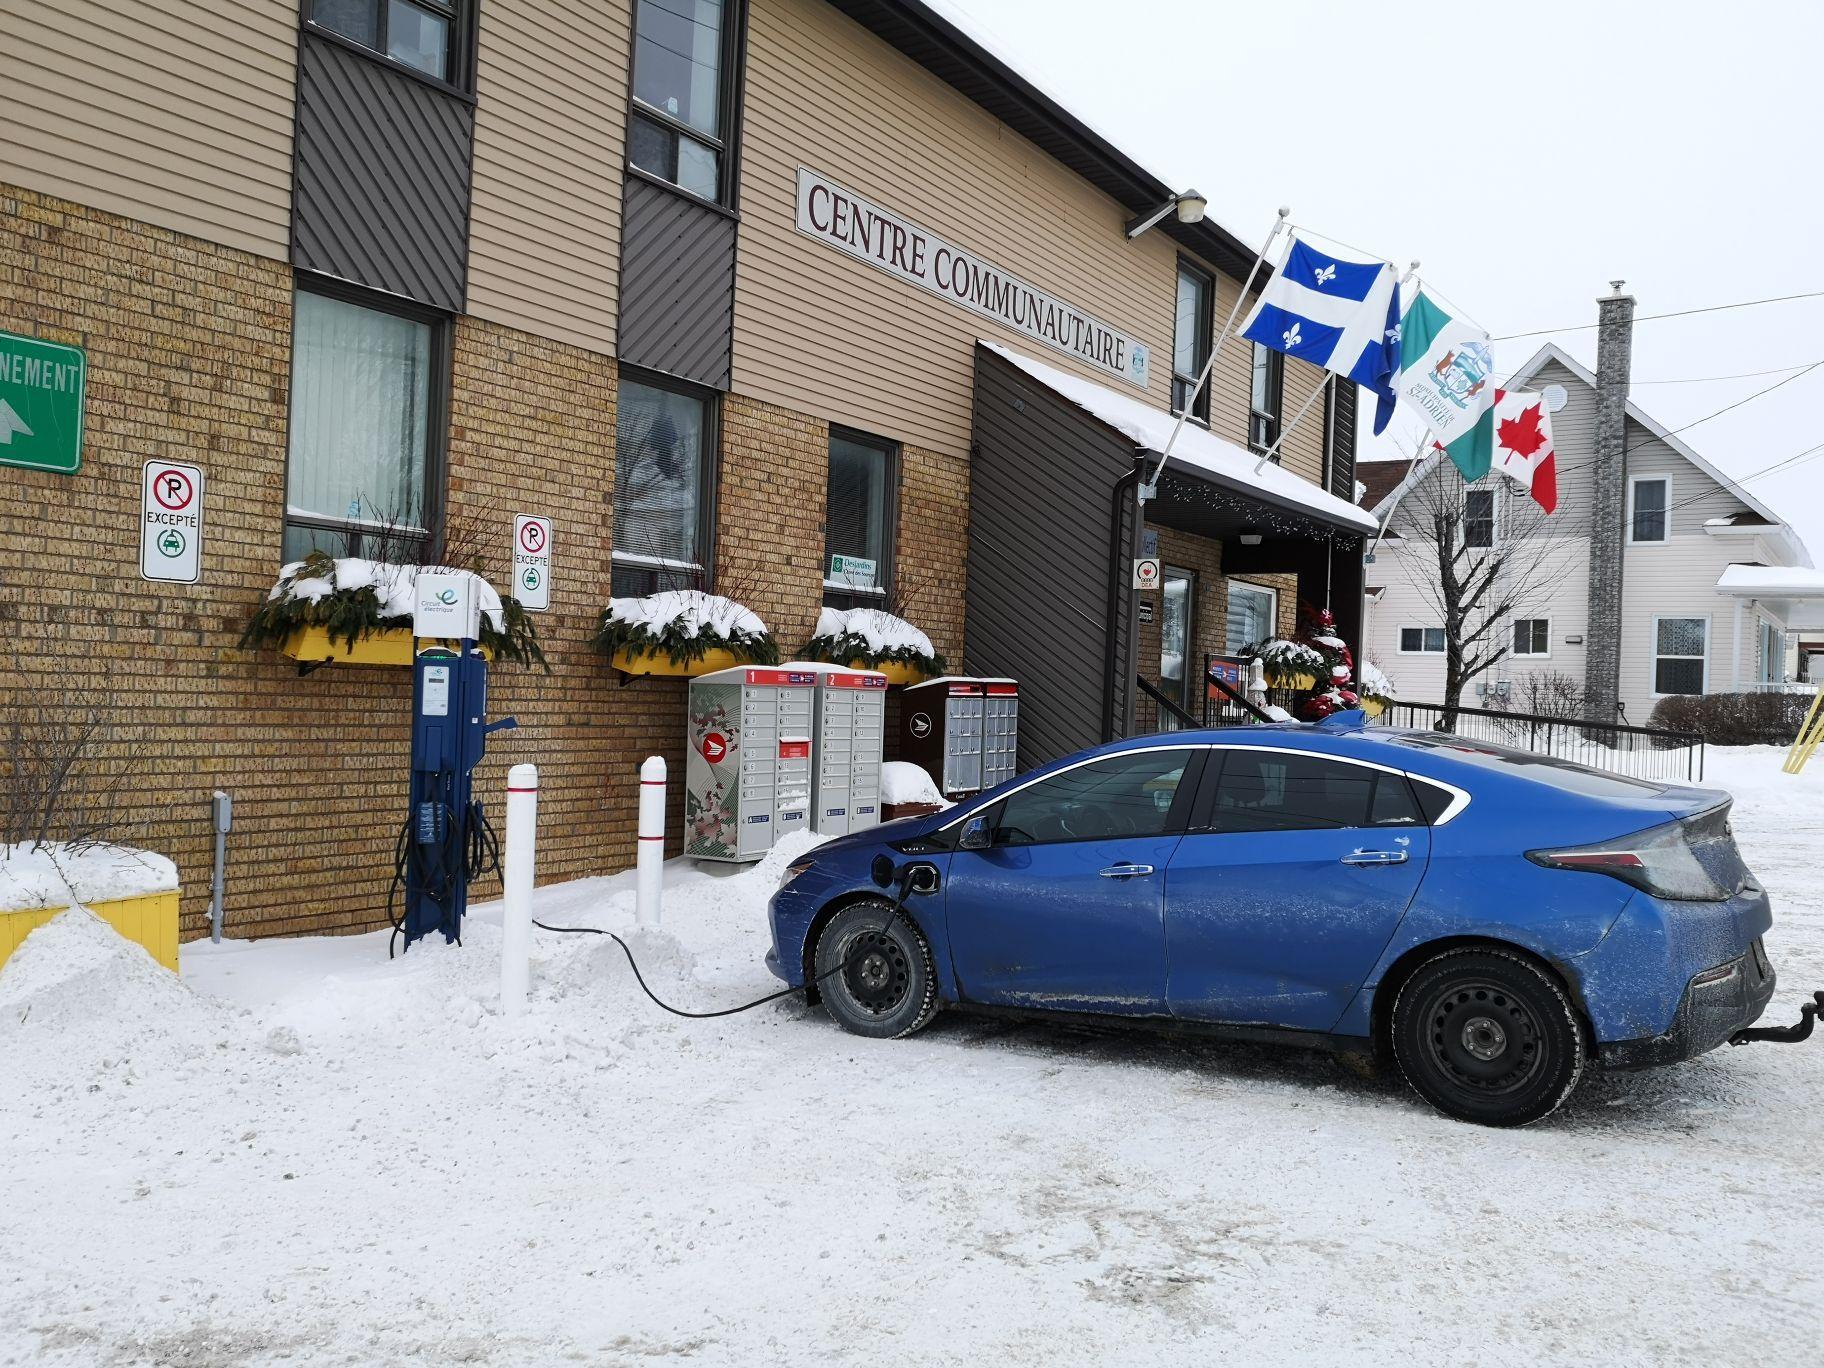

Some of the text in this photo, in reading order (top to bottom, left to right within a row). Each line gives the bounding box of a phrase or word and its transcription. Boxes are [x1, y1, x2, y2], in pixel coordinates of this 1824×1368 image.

[807, 184, 1125, 372] CENTRE COMMUNAUTAIRE
[168, 478, 182, 499] P
[147, 511, 197, 528] EXCEPTÉ
[529, 527, 539, 544] P
[516, 554, 548, 566] EXCEPTÉ
[844, 559, 872, 570] Desjardins
[750, 671, 755, 683] 1
[830, 674, 835, 686] 2
